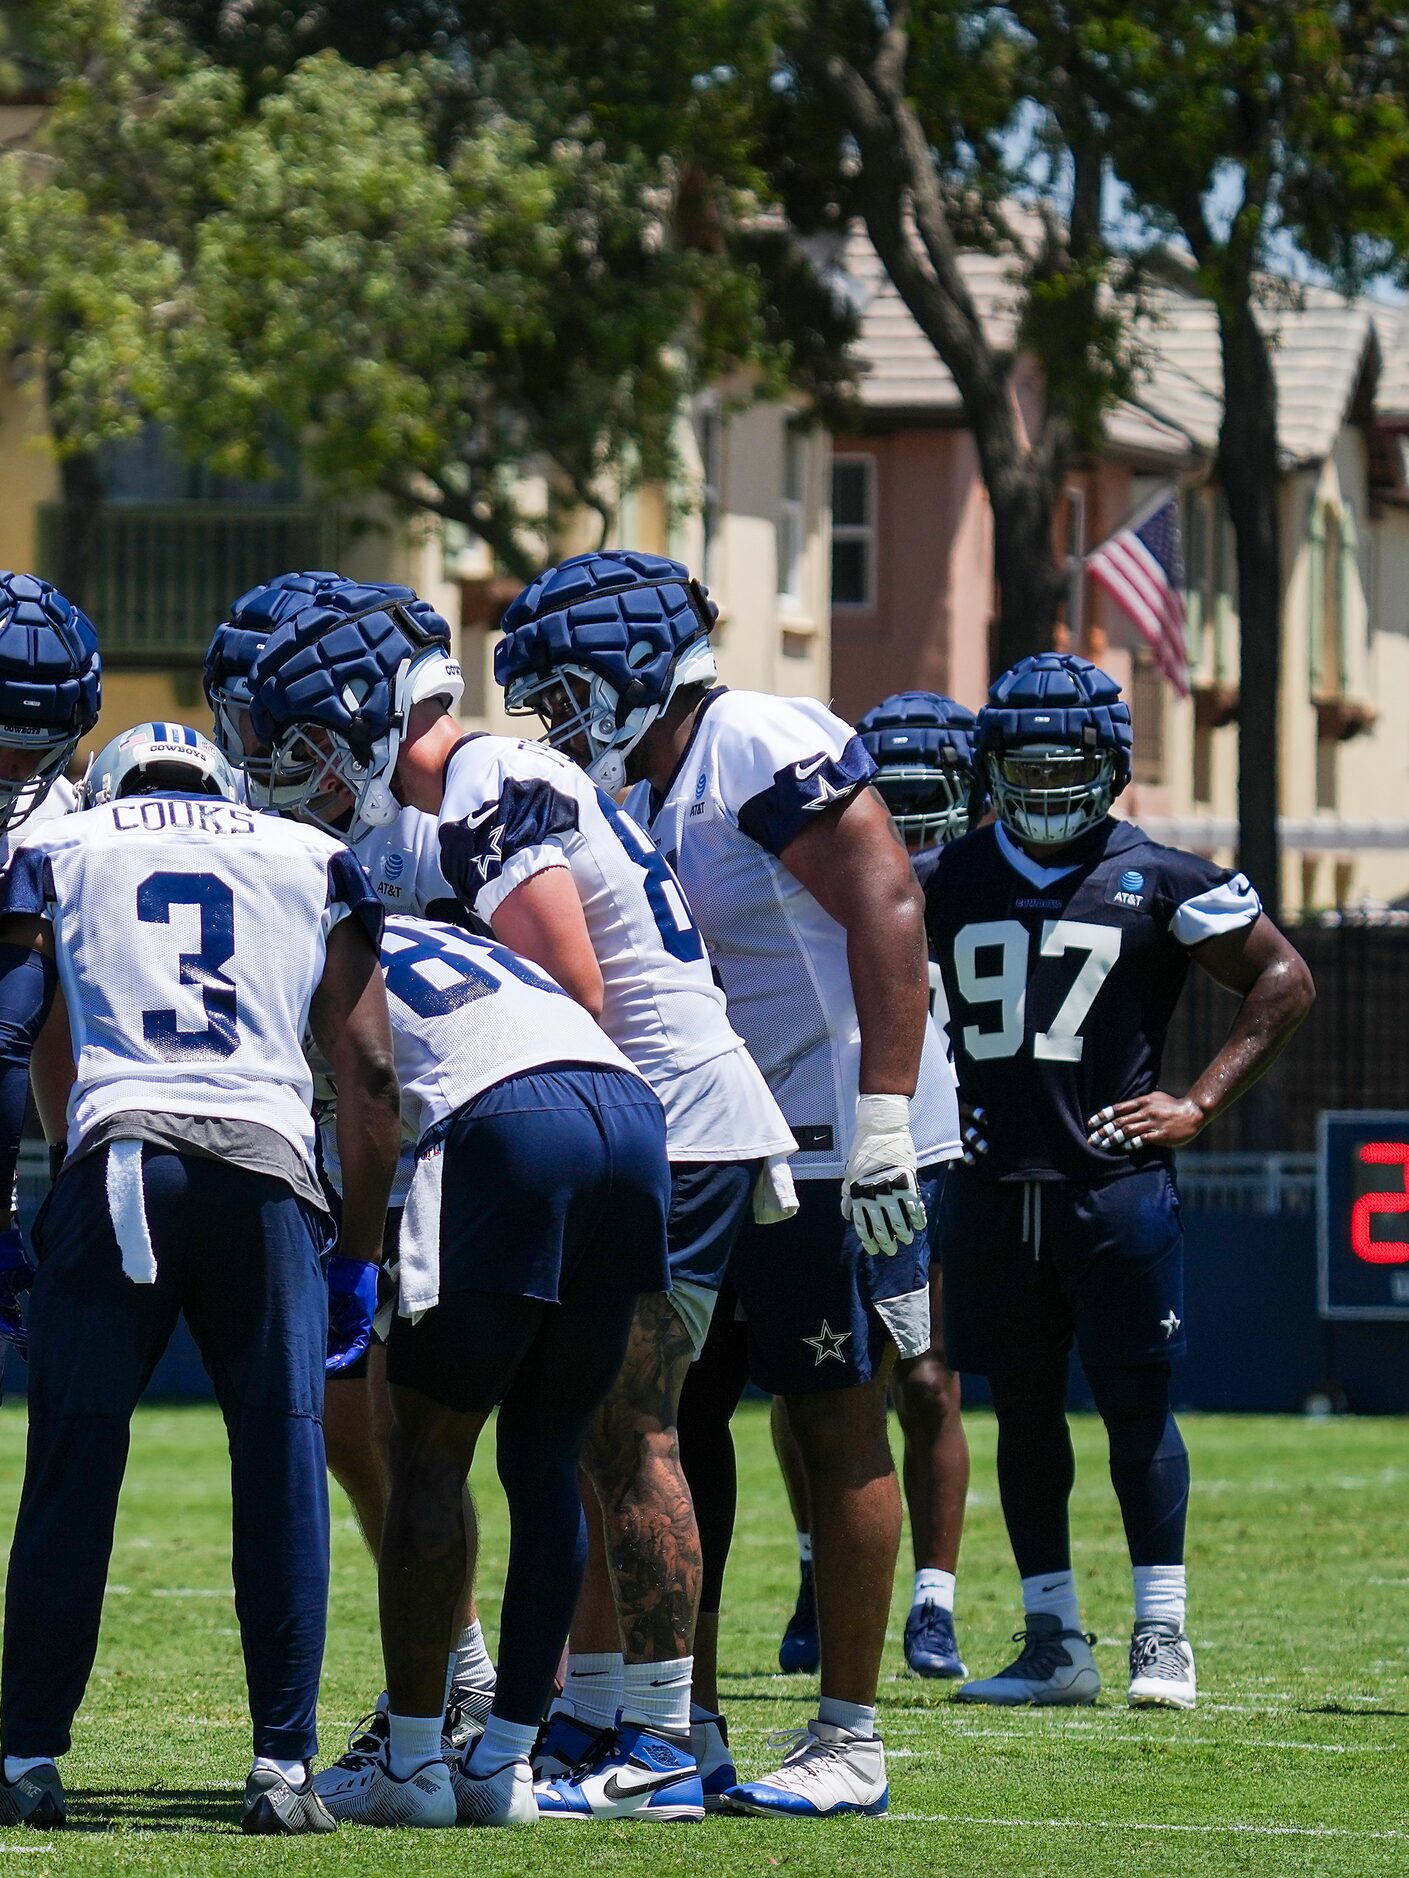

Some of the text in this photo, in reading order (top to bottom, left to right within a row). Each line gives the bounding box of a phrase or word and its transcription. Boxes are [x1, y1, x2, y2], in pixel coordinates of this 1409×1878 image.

[150, 744, 207, 761] COWBOYS
[112, 801, 255, 835] COOKS
[689, 802, 705, 818] AT&T
[377, 884, 403, 898] AT&T
[1113, 891, 1144, 907] AT&T
[136, 871, 241, 1063] 3
[953, 919, 1123, 1062] 97
[1351, 1142, 1409, 1264] 2
[16, 1777, 43, 1798] NIKE
[270, 1783, 290, 1808] NIKE
[412, 1774, 441, 1796] NIKE
